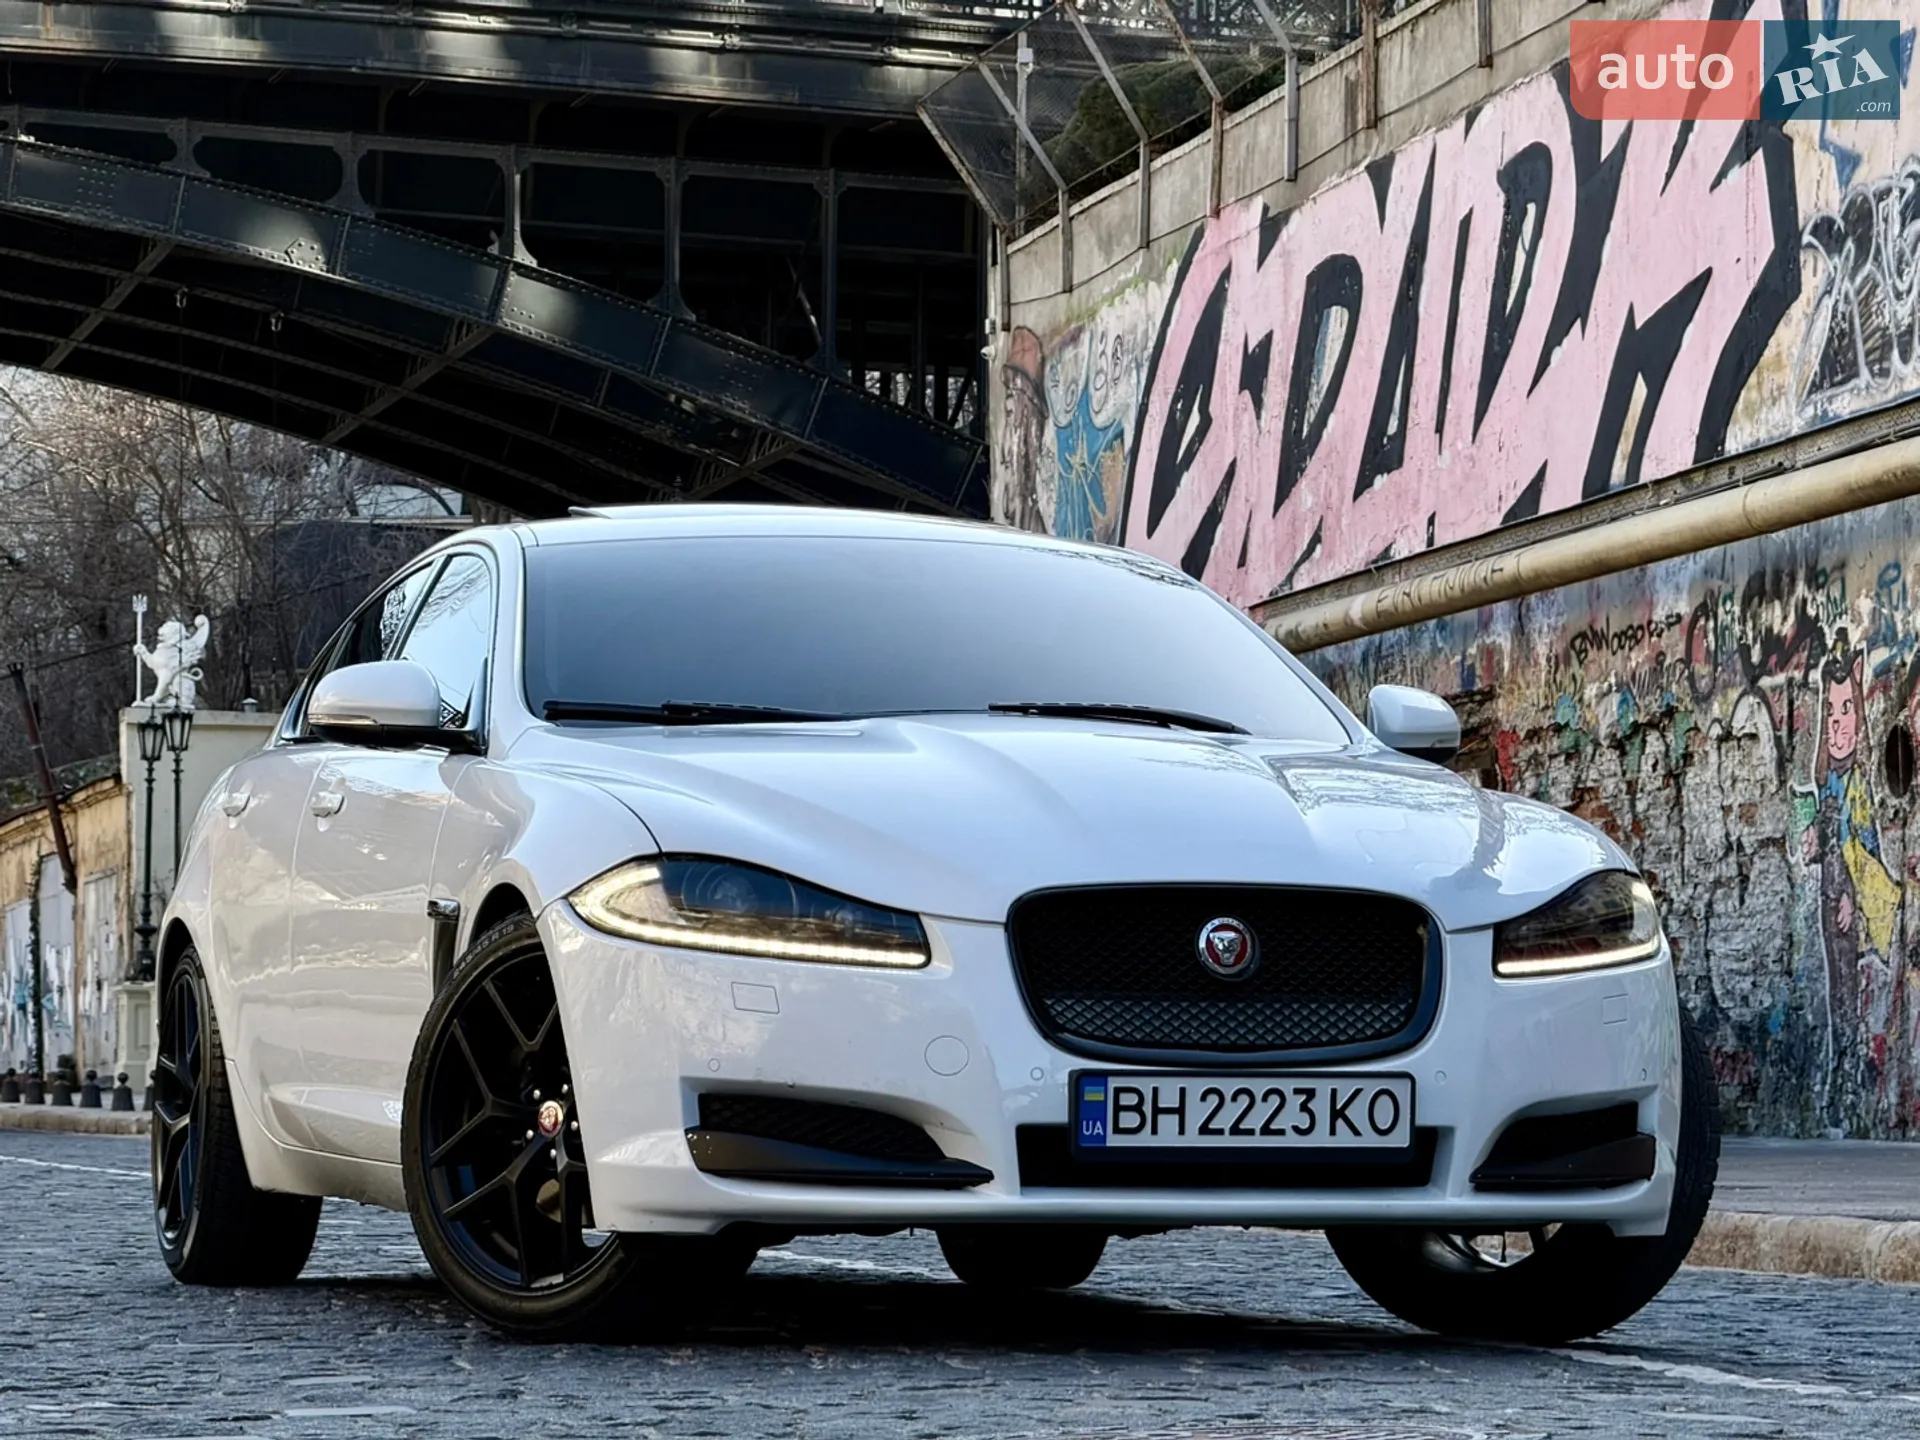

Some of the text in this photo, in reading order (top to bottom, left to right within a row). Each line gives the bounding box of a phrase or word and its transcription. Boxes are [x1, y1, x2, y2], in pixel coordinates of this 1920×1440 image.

[1082, 1119, 1104, 1136] UA
[1111, 1086, 1400, 1137] BH 2223 KO
